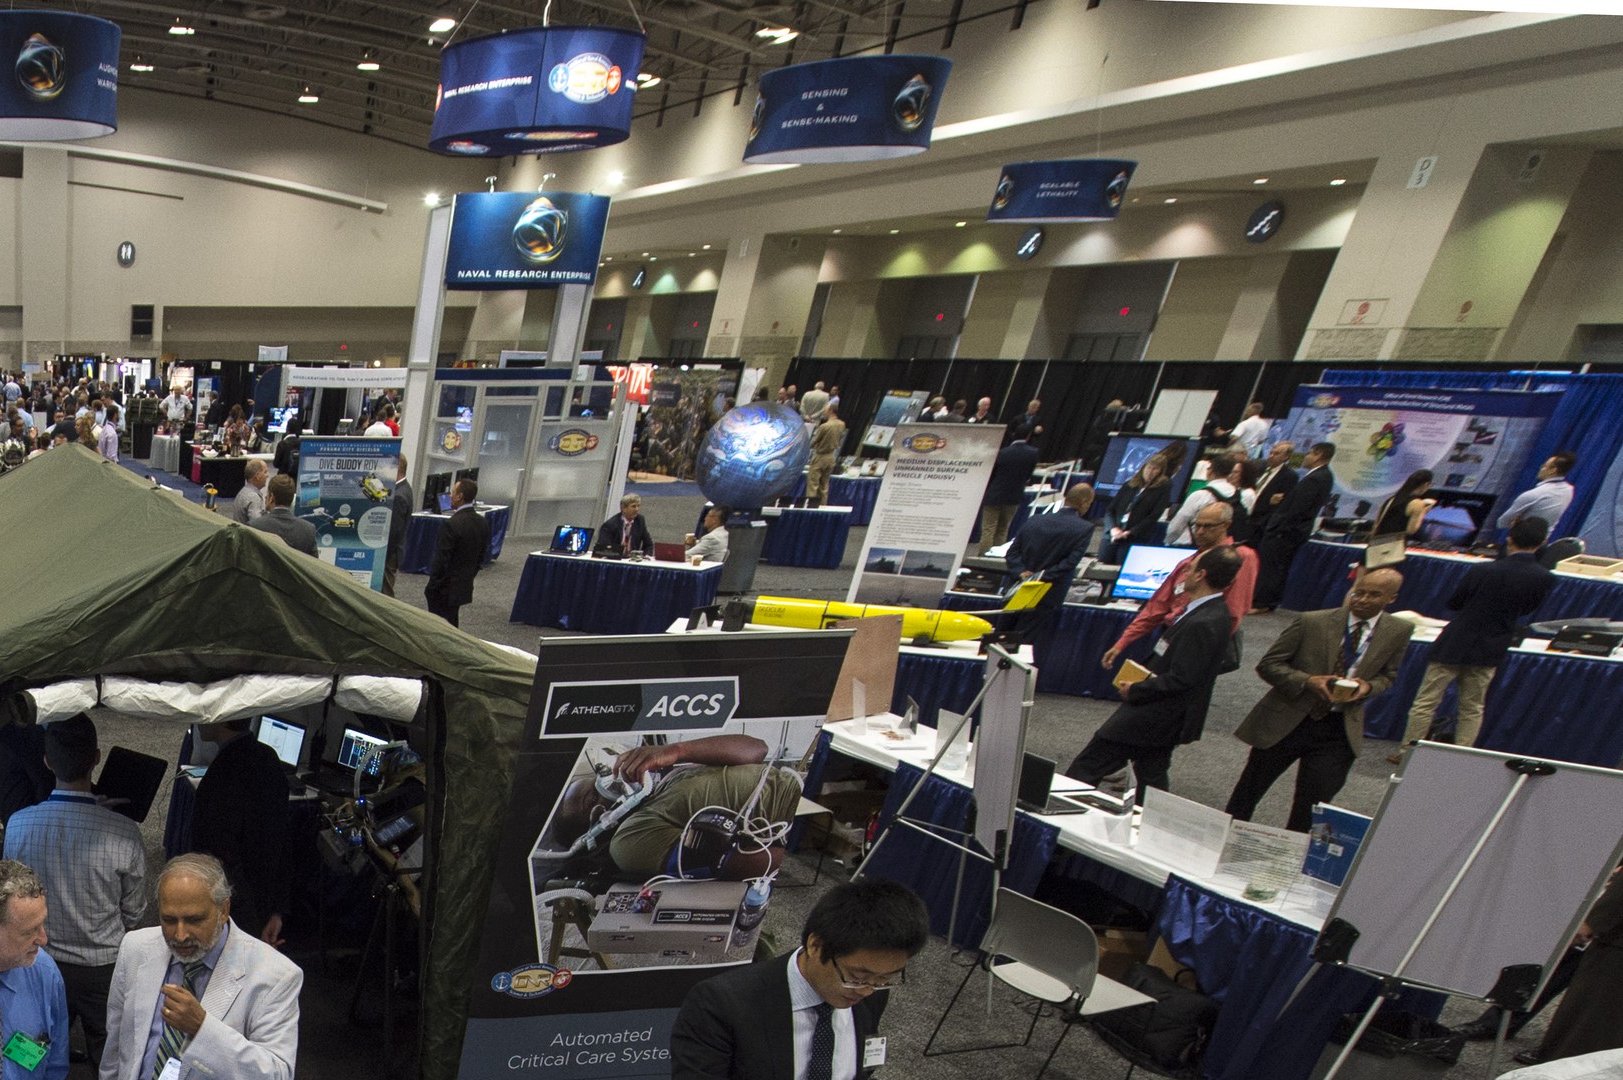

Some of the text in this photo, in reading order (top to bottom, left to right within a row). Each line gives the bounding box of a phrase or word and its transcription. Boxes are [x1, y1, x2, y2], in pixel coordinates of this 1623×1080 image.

[458, 82, 488, 96] RESEARCH
[488, 76, 533, 91] ENTERPRISE
[801, 87, 849, 100] SENSING
[780, 114, 859, 129] SENSE-MAKING
[1039, 180, 1081, 189] SCALABLE
[1036, 190, 1079, 198] LETHALITY
[457, 270, 592, 280] NAVAL RESEARCH ENTERPRISE
[319, 458, 379, 471] DIVE BUDDY ROV
[894, 465, 969, 475] UNMANNED SURFACE
[928, 459, 984, 468] DISPLACEMENT
[571, 693, 725, 718] ATHENAGTX ACCS
[514, 973, 552, 989] ONR
[550, 1026, 653, 1048] Automated
[507, 1046, 672, 1070] Critical Care Syste
